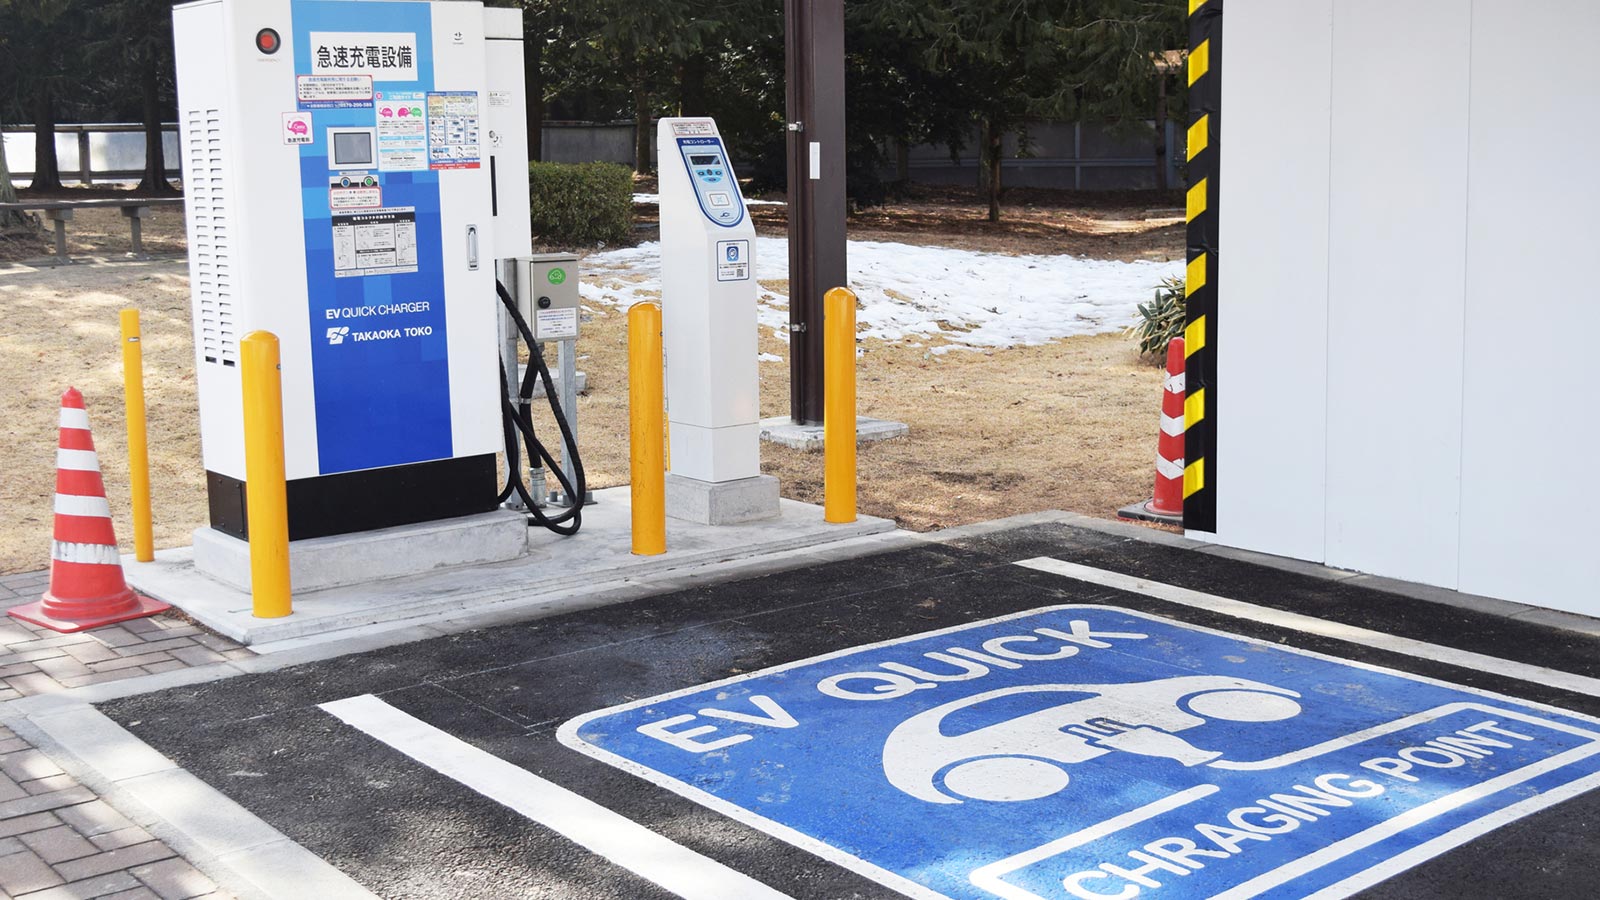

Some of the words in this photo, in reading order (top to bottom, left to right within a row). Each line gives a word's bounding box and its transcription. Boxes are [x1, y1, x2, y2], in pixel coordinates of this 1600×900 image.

[317, 45, 412, 68] 急速充電設備
[326, 308, 340, 319] EV
[342, 305, 377, 318] QUICK
[378, 301, 430, 315] CHARGER
[352, 328, 401, 342] TAKAOKA
[404, 326, 433, 337] TOKO
[636, 695, 799, 753] EV
[817, 620, 1148, 700] QUICK
[1063, 773, 1385, 900] CHRAGING
[1360, 720, 1534, 782] POINT
